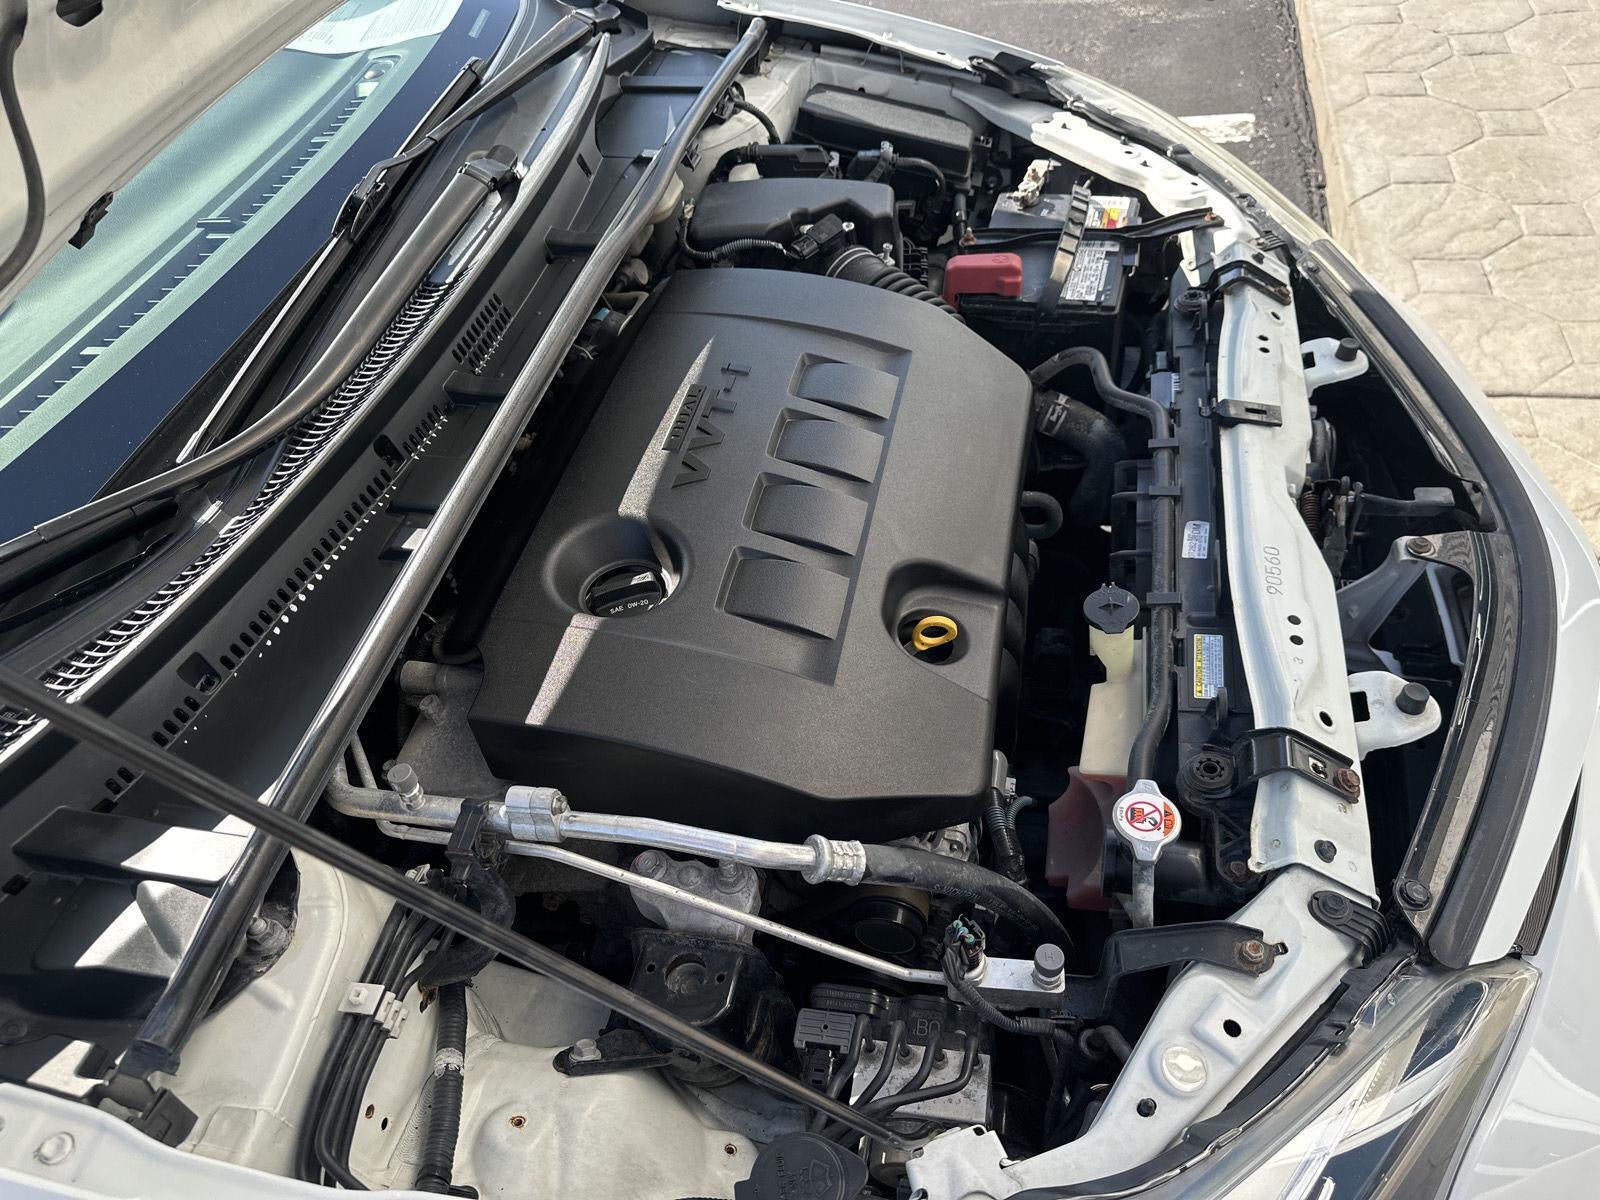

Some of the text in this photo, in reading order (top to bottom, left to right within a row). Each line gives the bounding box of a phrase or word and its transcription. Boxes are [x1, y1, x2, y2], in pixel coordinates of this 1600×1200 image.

[671, 389, 701, 440] DUAL
[1262, 546, 1284, 596] 90560
[609, 598, 649, 615] SAE 0W-20
